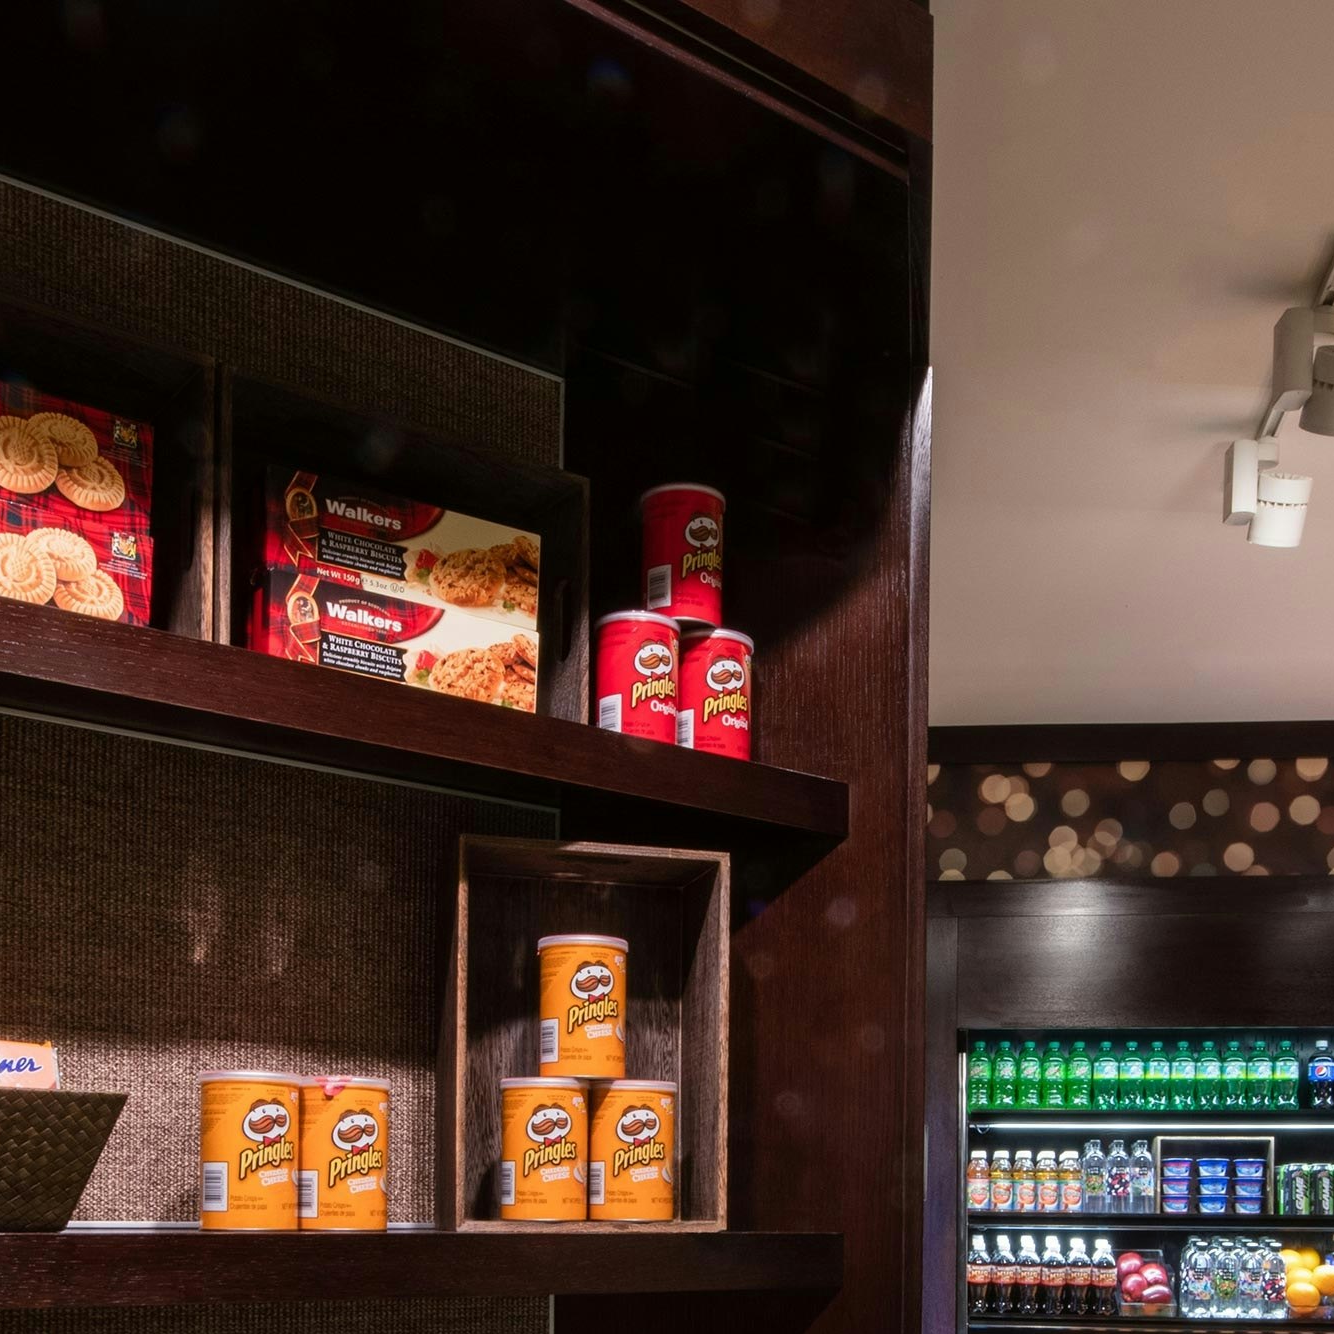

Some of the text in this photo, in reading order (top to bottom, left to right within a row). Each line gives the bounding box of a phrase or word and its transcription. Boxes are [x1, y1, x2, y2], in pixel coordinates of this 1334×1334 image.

[326, 499, 401, 530] Walkers
[317, 567, 329, 576] Net
[326, 602, 402, 632] Walkers
[329, 635, 397, 656] WHITE CHOCOLATE
[632, 675, 675, 709] Pringles
[703, 690, 748, 723] Pringles
[568, 996, 617, 1033] Pringles
[240, 1138, 293, 1179] Pringles
[329, 1147, 382, 1187] Pringles
[524, 1138, 576, 1176] Pringles
[614, 1139, 664, 1176] Pringles
[1296, 1178, 1304, 1209] GAME
[1322, 1178, 1330, 1209] GAME
